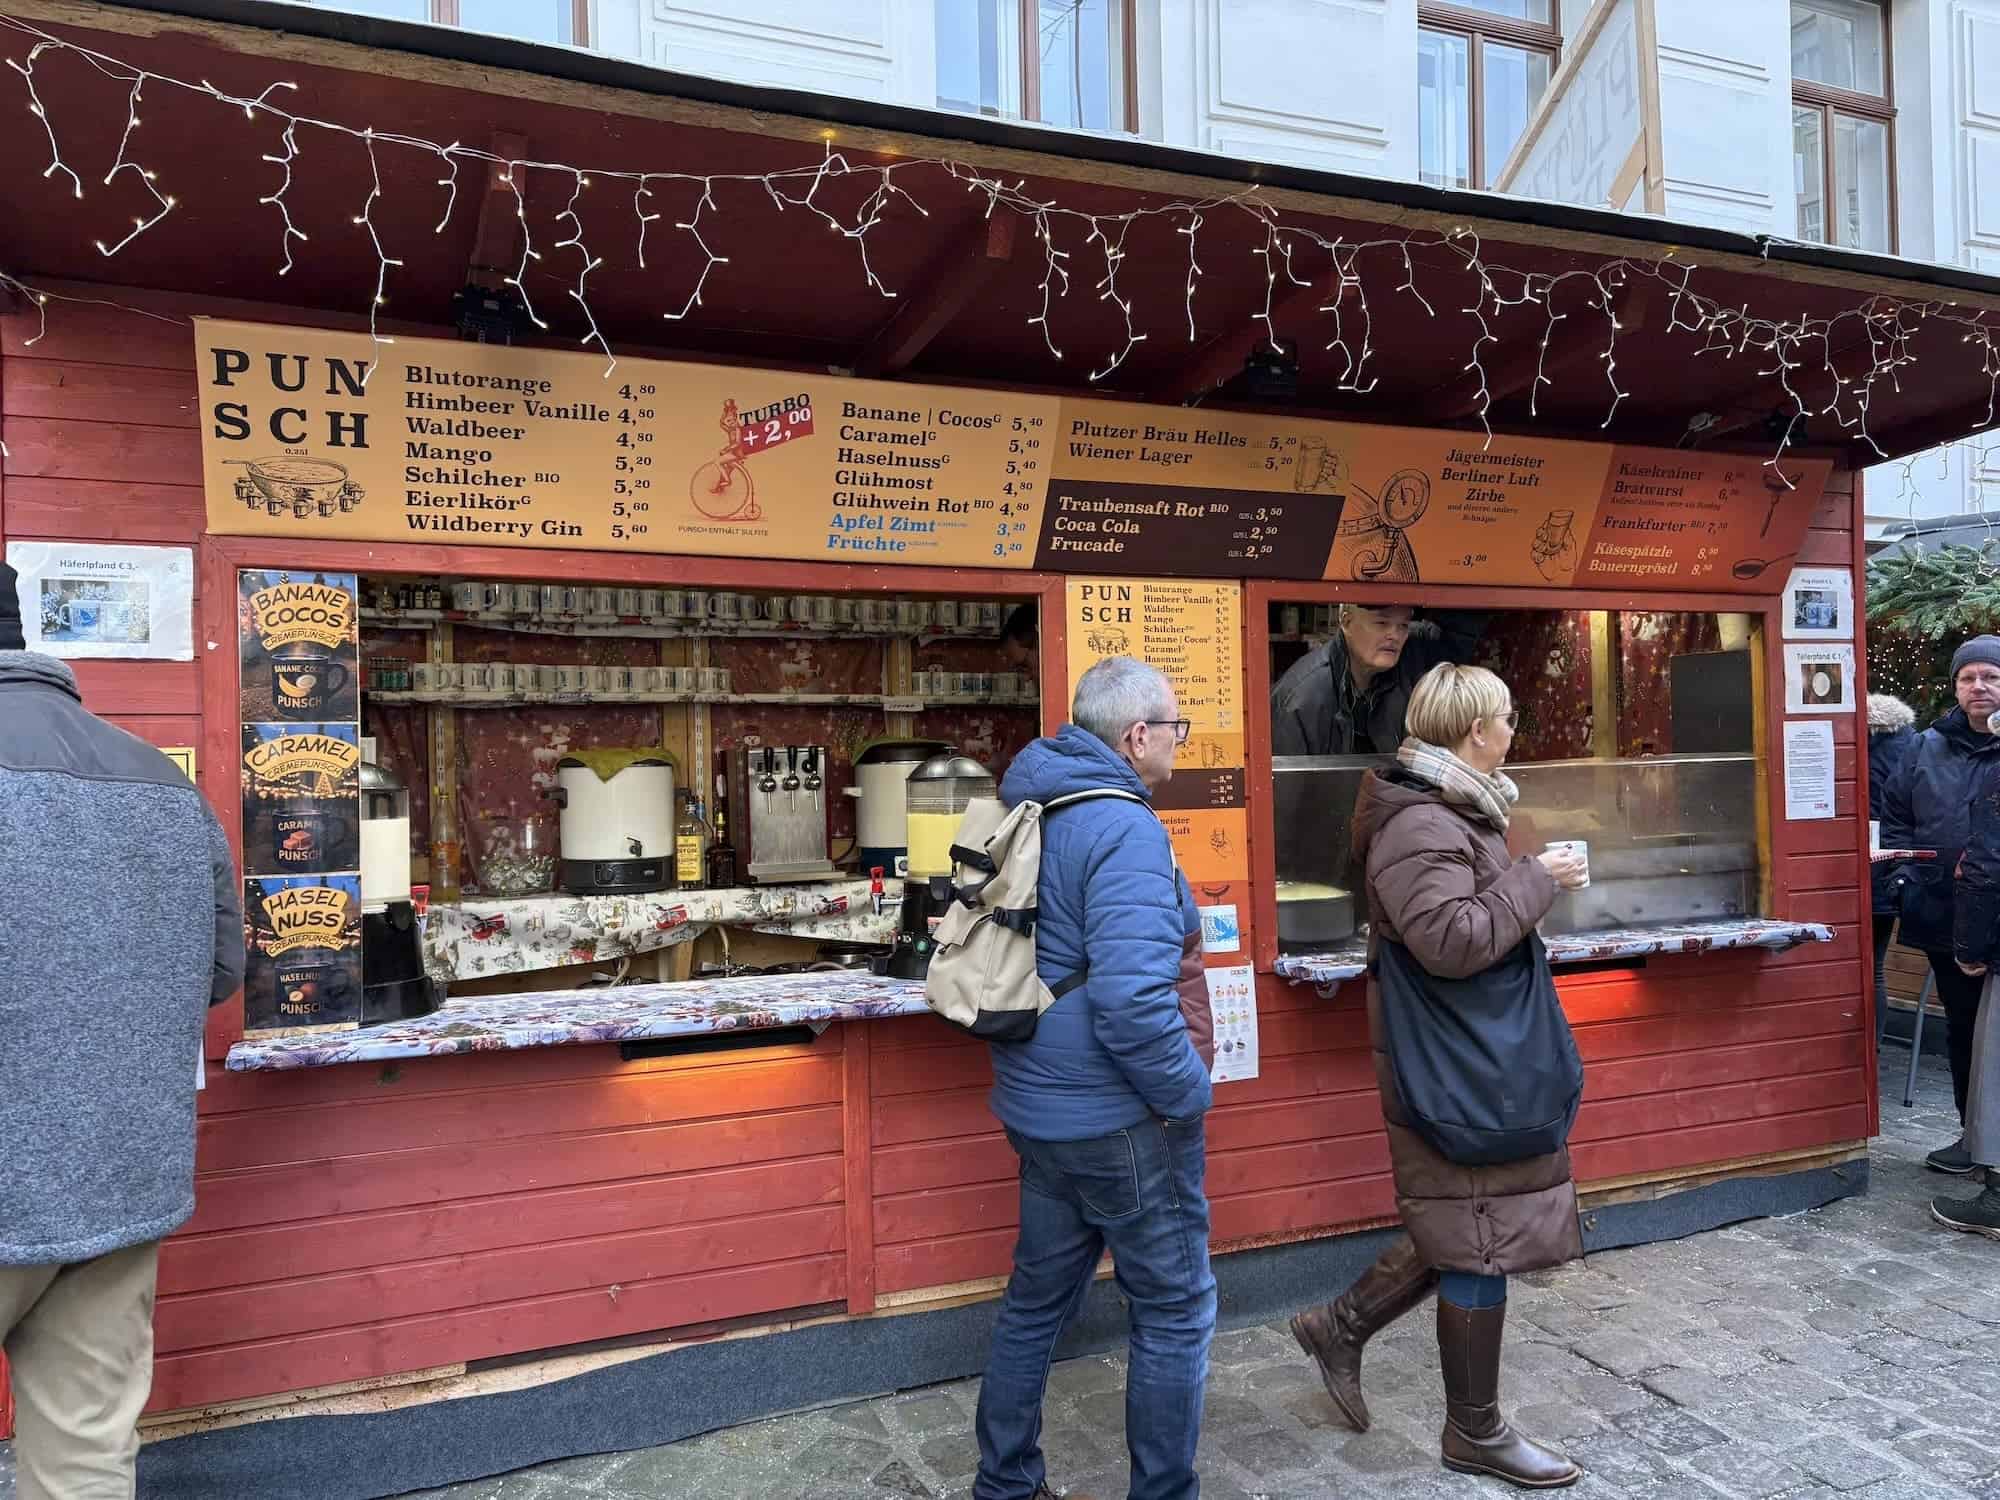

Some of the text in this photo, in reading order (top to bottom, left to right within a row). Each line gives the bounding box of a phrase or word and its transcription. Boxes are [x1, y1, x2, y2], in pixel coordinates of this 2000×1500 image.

[210, 347, 369, 397] PUN
[405, 365, 656, 401] Blutorange 4,80
[405, 391, 655, 426] Himbeer Vanille 4,80
[739, 393, 810, 427] TURBO
[842, 402, 921, 423] Banane
[1011, 417, 1043, 433] 5,40
[214, 402, 370, 449] SCH
[405, 416, 653, 450] Waldbeer 4,80
[1071, 420, 1138, 440] Plutzer
[1143, 425, 1188, 442] Bräu
[1193, 429, 1248, 448] Helles
[405, 442, 652, 474] Mango 5,20
[1008, 439, 1040, 454] 5,40
[1068, 443, 1134, 461] Wiener
[1139, 447, 1193, 466] Lager
[1005, 461, 1037, 475] 5,40
[1446, 449, 1544, 468] Jägermeister
[405, 466, 650, 496] Schilcher BIO 5,20
[835, 470, 1033, 498] Glühmost 4,80
[1440, 468, 1540, 486] Berliner Luft
[1614, 480, 1684, 497] Bratwurst
[832, 491, 1030, 518] Glühwein Rot BIO 4,80
[1466, 488, 1505, 502] Zirbe
[612, 501, 649, 519] 5,60
[1058, 496, 1170, 516] Traubensaft
[1174, 502, 1204, 517] Rot
[1210, 503, 1229, 513] BIO
[1256, 507, 1283, 522] 3,50
[405, 513, 648, 541] Wildberry Gin 5,60
[829, 513, 884, 532] Apfel
[889, 516, 936, 532] Zimt
[996, 523, 1026, 537] 3,20
[1054, 517, 1096, 532] Coca
[1102, 519, 1140, 534] Cola
[1250, 526, 1278, 541] 2,50
[1602, 516, 1687, 532] Frankfurter
[827, 534, 906, 552] Früchte
[993, 543, 1022, 557] 3,20
[1050, 537, 1124, 553] Frucade
[1245, 545, 1273, 560] 2,50
[1594, 542, 1673, 559] Käsespätzle
[1589, 560, 1678, 576] Bauerngröstl
[256, 585, 346, 611] BANANE
[1081, 585, 1131, 601] PUN
[265, 607, 345, 628] COCOS
[1081, 606, 1131, 623] SCH
[1144, 615, 1174, 625] Mango
[264, 630, 341, 648] CREMEPUNSCH
[252, 737, 352, 766] CARAMEL
[266, 760, 342, 778] CREMEPUNSCH
[268, 890, 338, 914] HASEL
[279, 911, 340, 931] NUSS
[269, 934, 343, 954] CREMEPUNSCH
